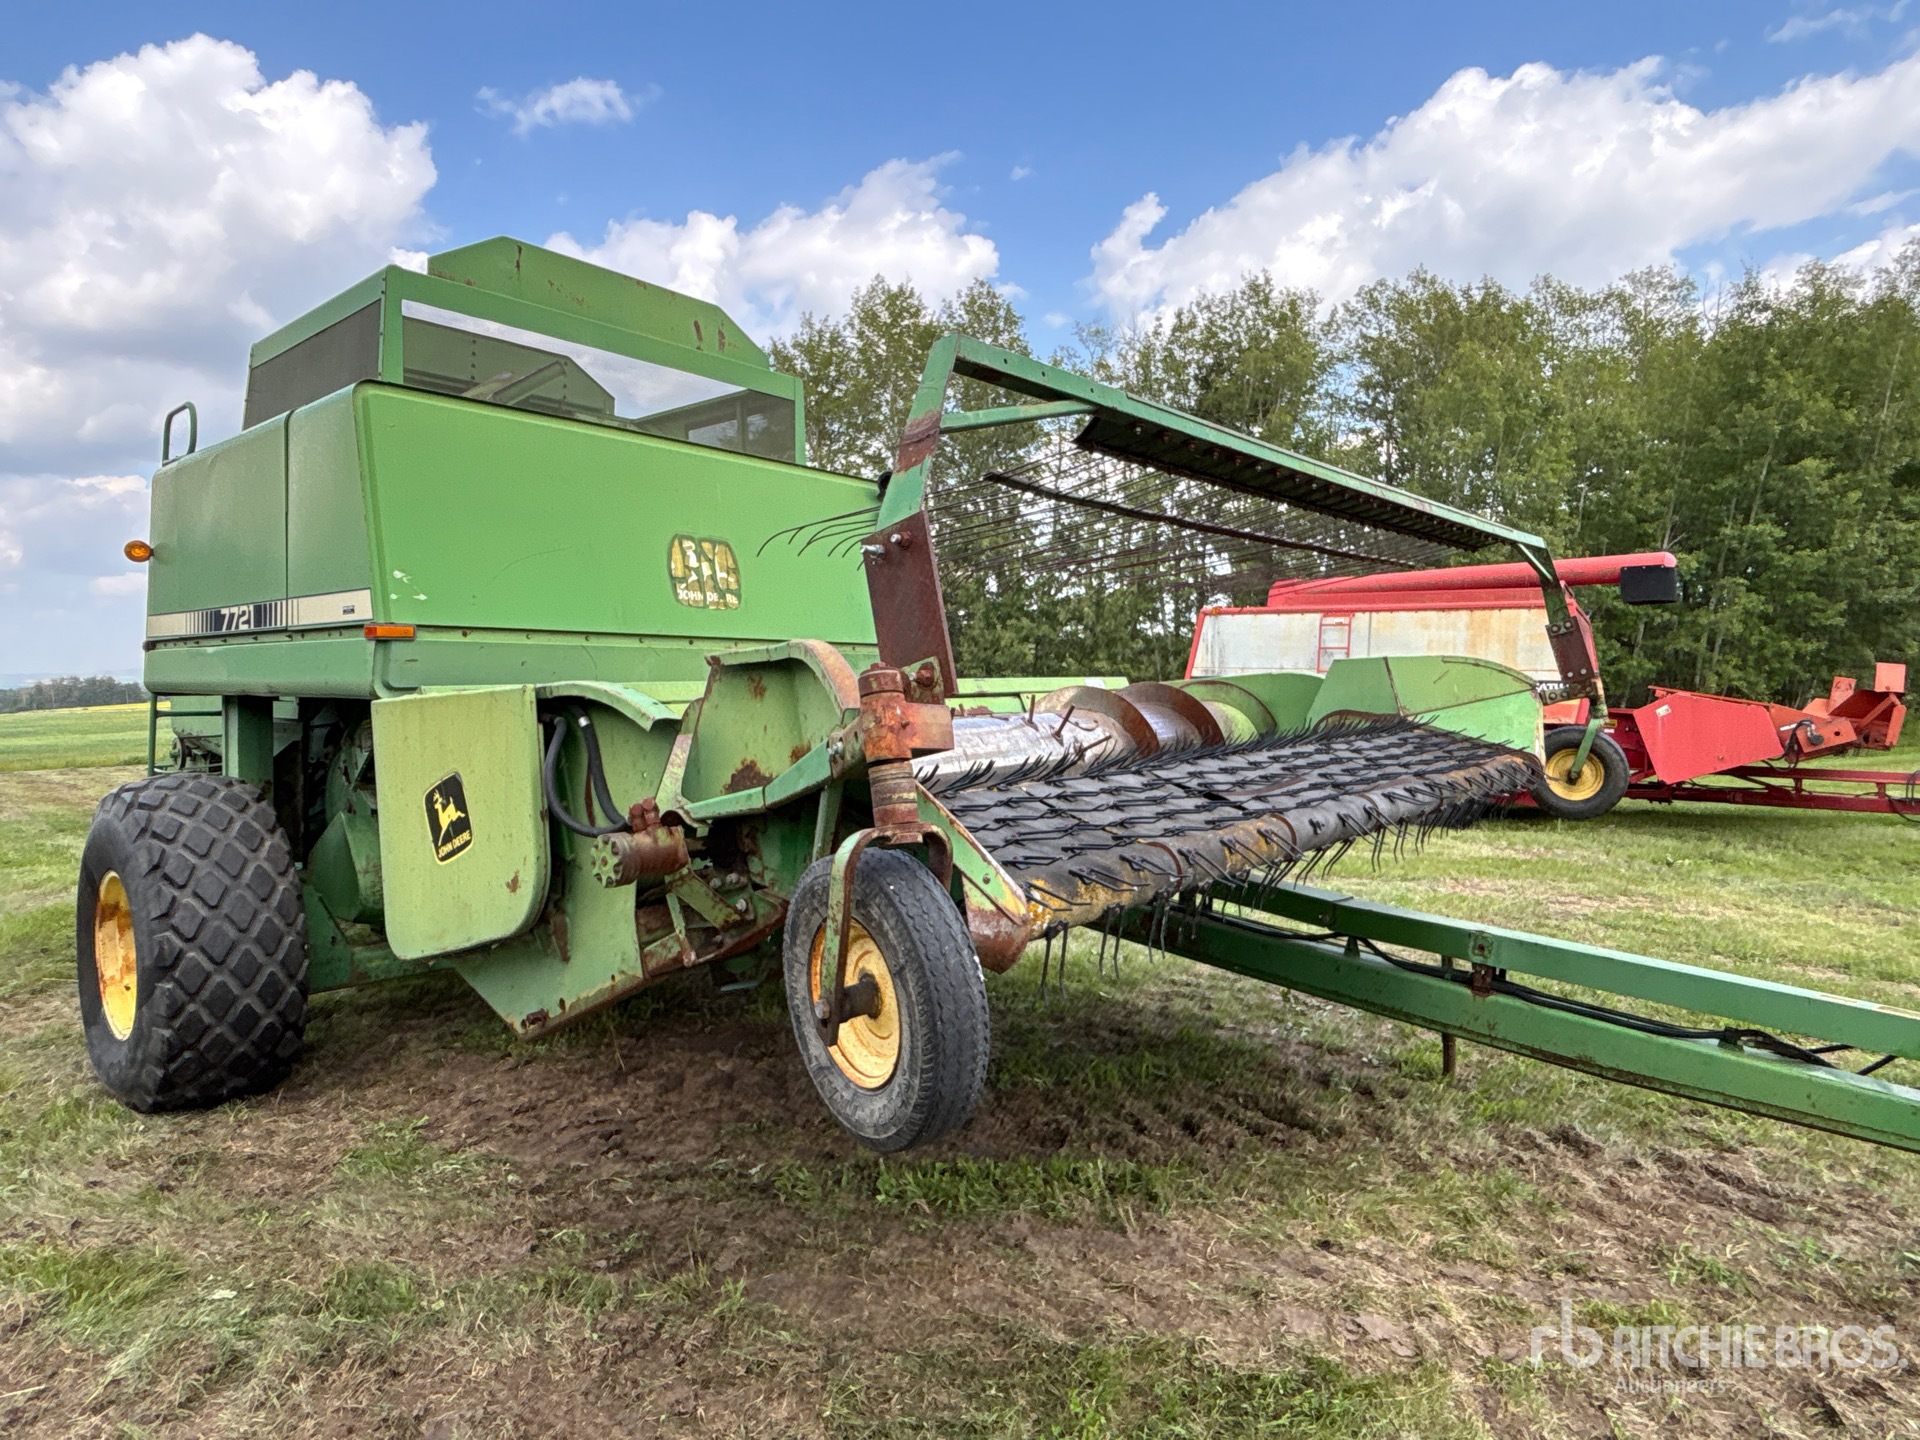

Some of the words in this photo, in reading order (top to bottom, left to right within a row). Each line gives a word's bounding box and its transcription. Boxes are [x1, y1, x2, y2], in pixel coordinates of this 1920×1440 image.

[706, 591, 739, 605] DERE
[220, 604, 254, 632] 7721
[438, 842, 453, 858] JOHN
[453, 830, 471, 849] DEERE
